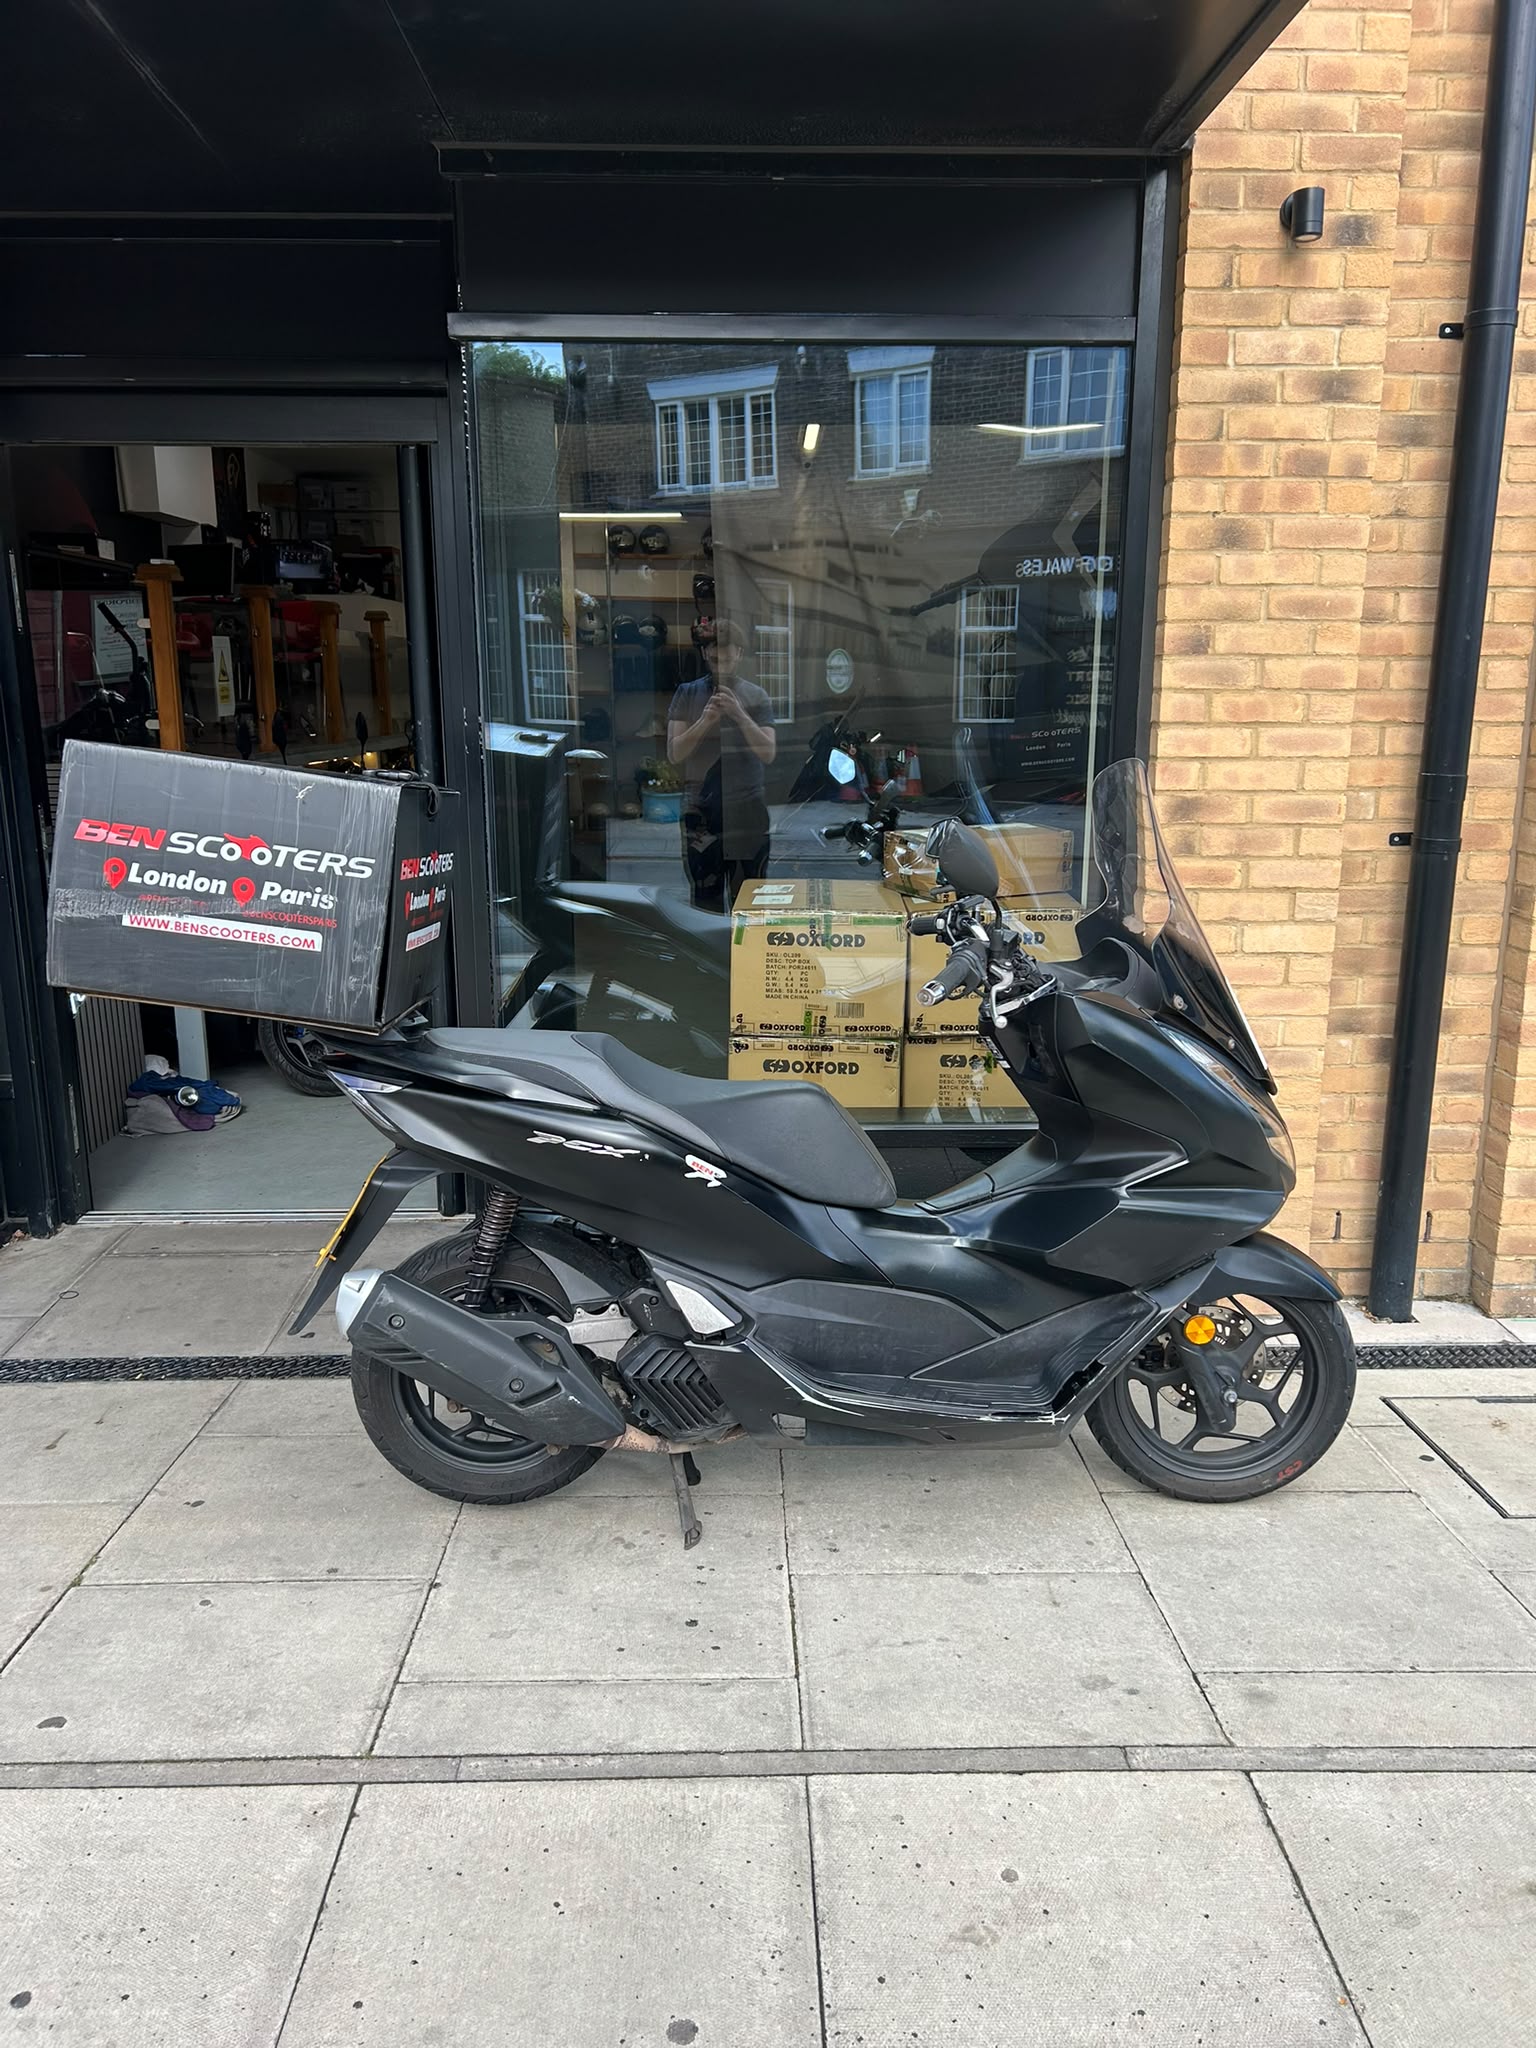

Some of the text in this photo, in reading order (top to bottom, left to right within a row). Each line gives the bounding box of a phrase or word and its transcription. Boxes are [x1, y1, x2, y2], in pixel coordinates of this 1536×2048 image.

[127, 862, 336, 910] London Paris
[129, 914, 316, 950] WWW.BENSCOOTERS.COM
[796, 932, 866, 948] OXFORD
[773, 1024, 806, 1032] OXFORD
[791, 1061, 860, 1075] OXFORD
